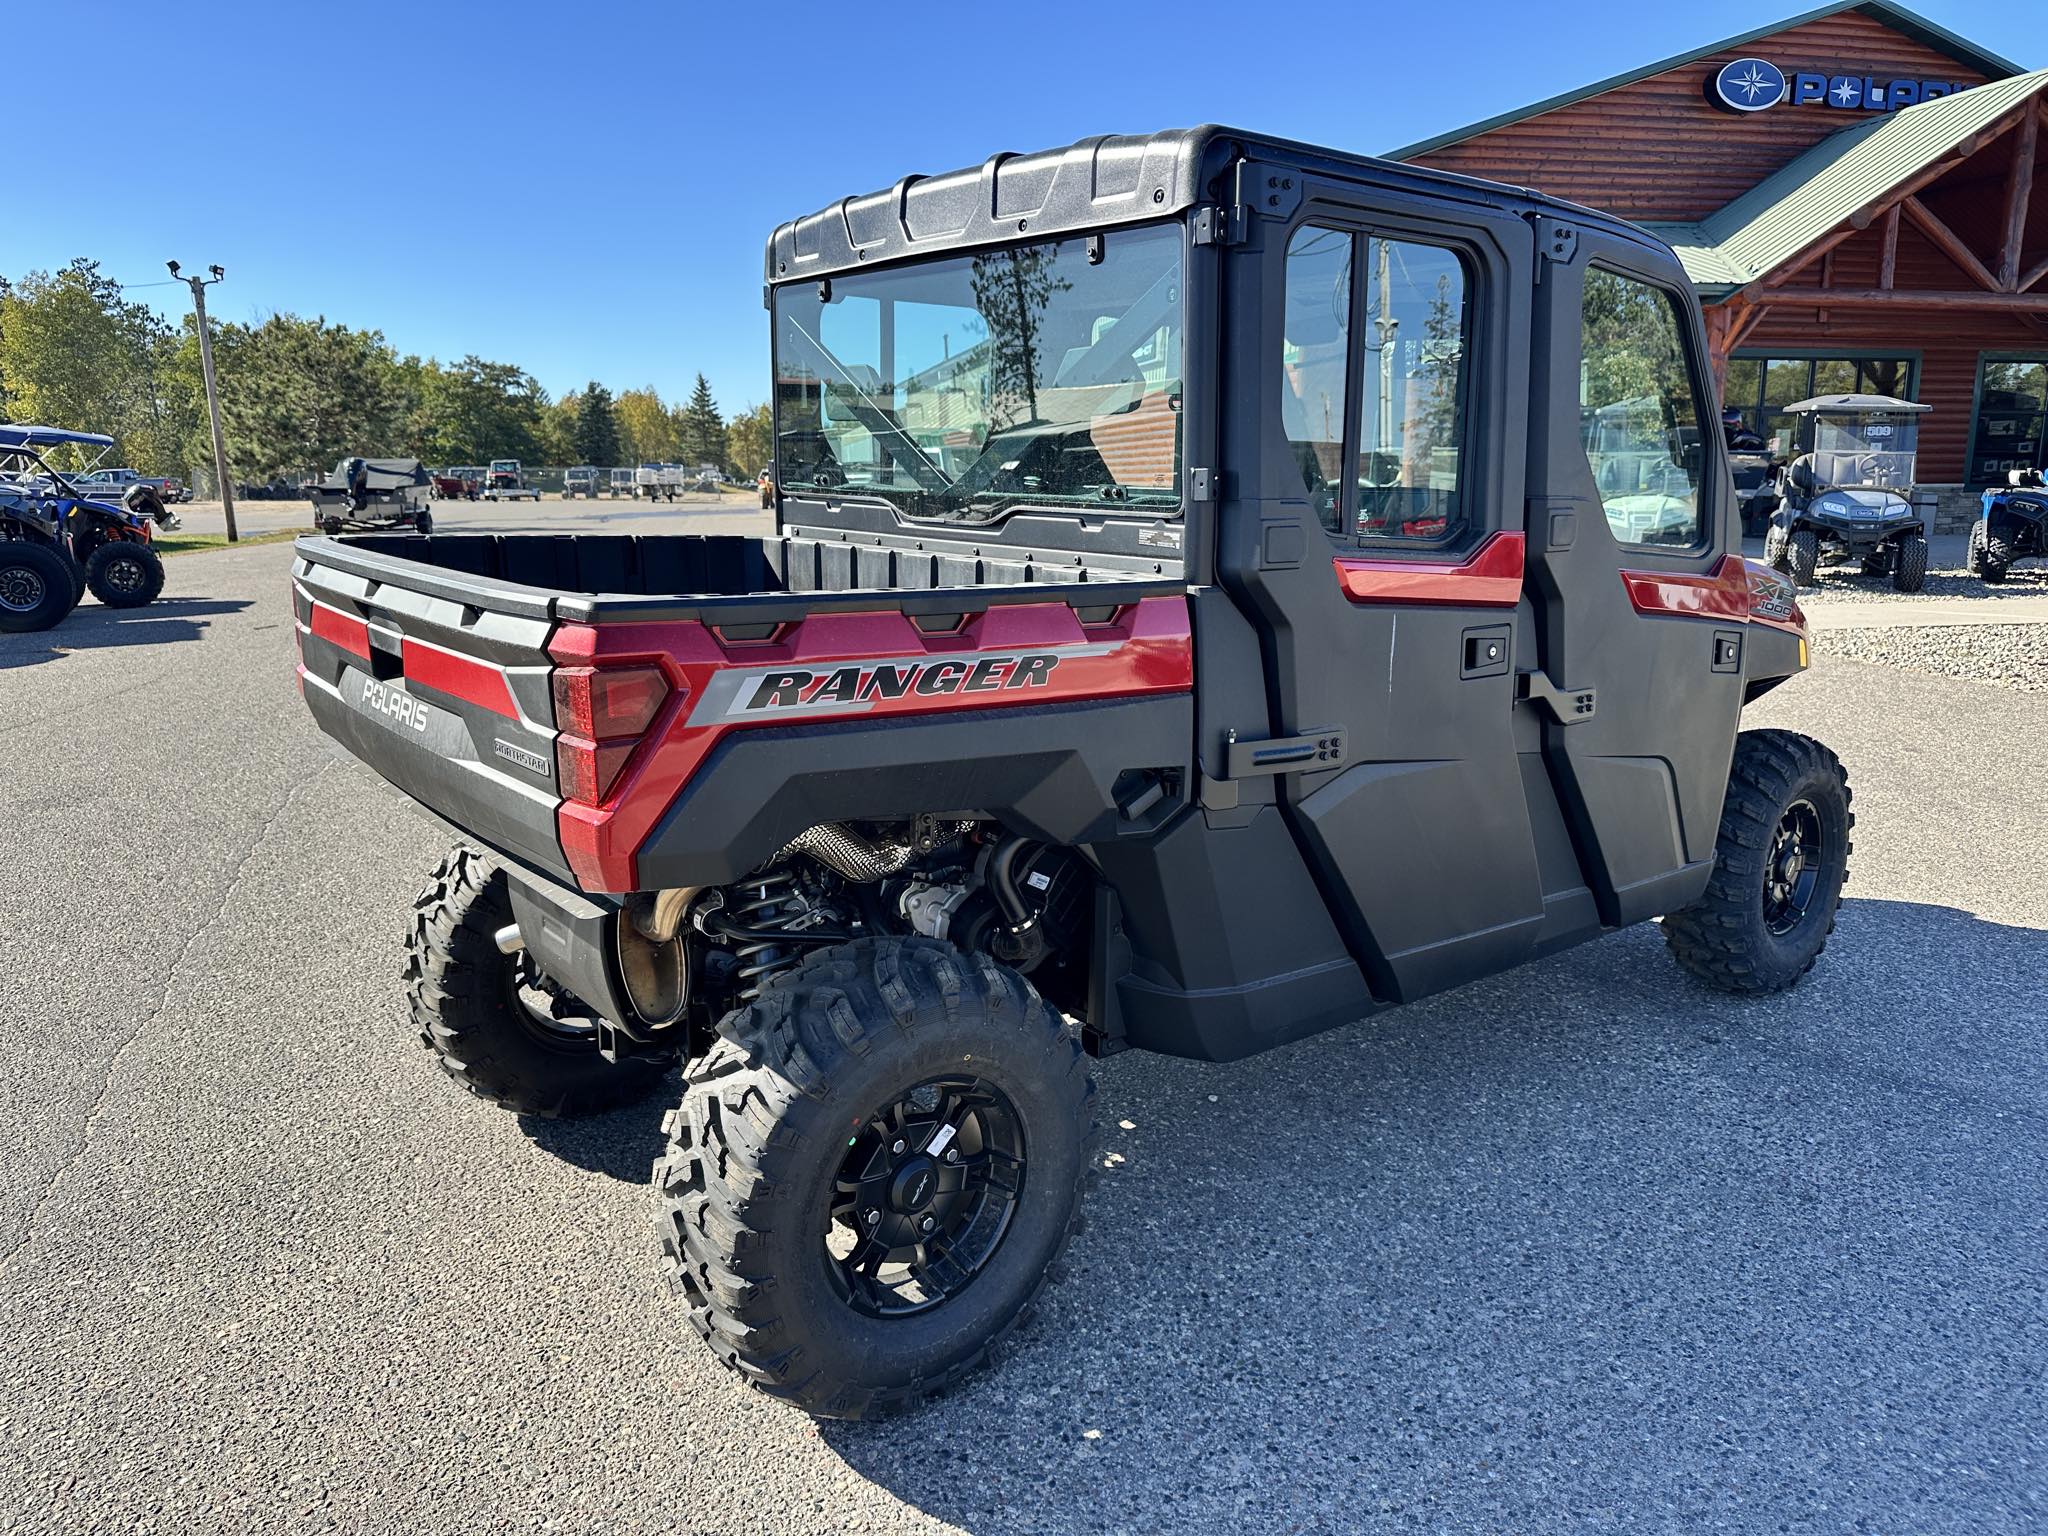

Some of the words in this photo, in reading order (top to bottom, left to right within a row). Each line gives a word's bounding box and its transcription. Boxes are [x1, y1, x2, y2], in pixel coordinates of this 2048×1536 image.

[1792, 72, 1978, 111] POLAR
[1867, 426, 1891, 436] 509
[1751, 577, 1795, 601] XP
[1761, 600, 1792, 616] 1000
[745, 654, 1059, 710] RANGER
[361, 678, 429, 733] POLARIS
[496, 743, 544, 772] NORTHSTAR
